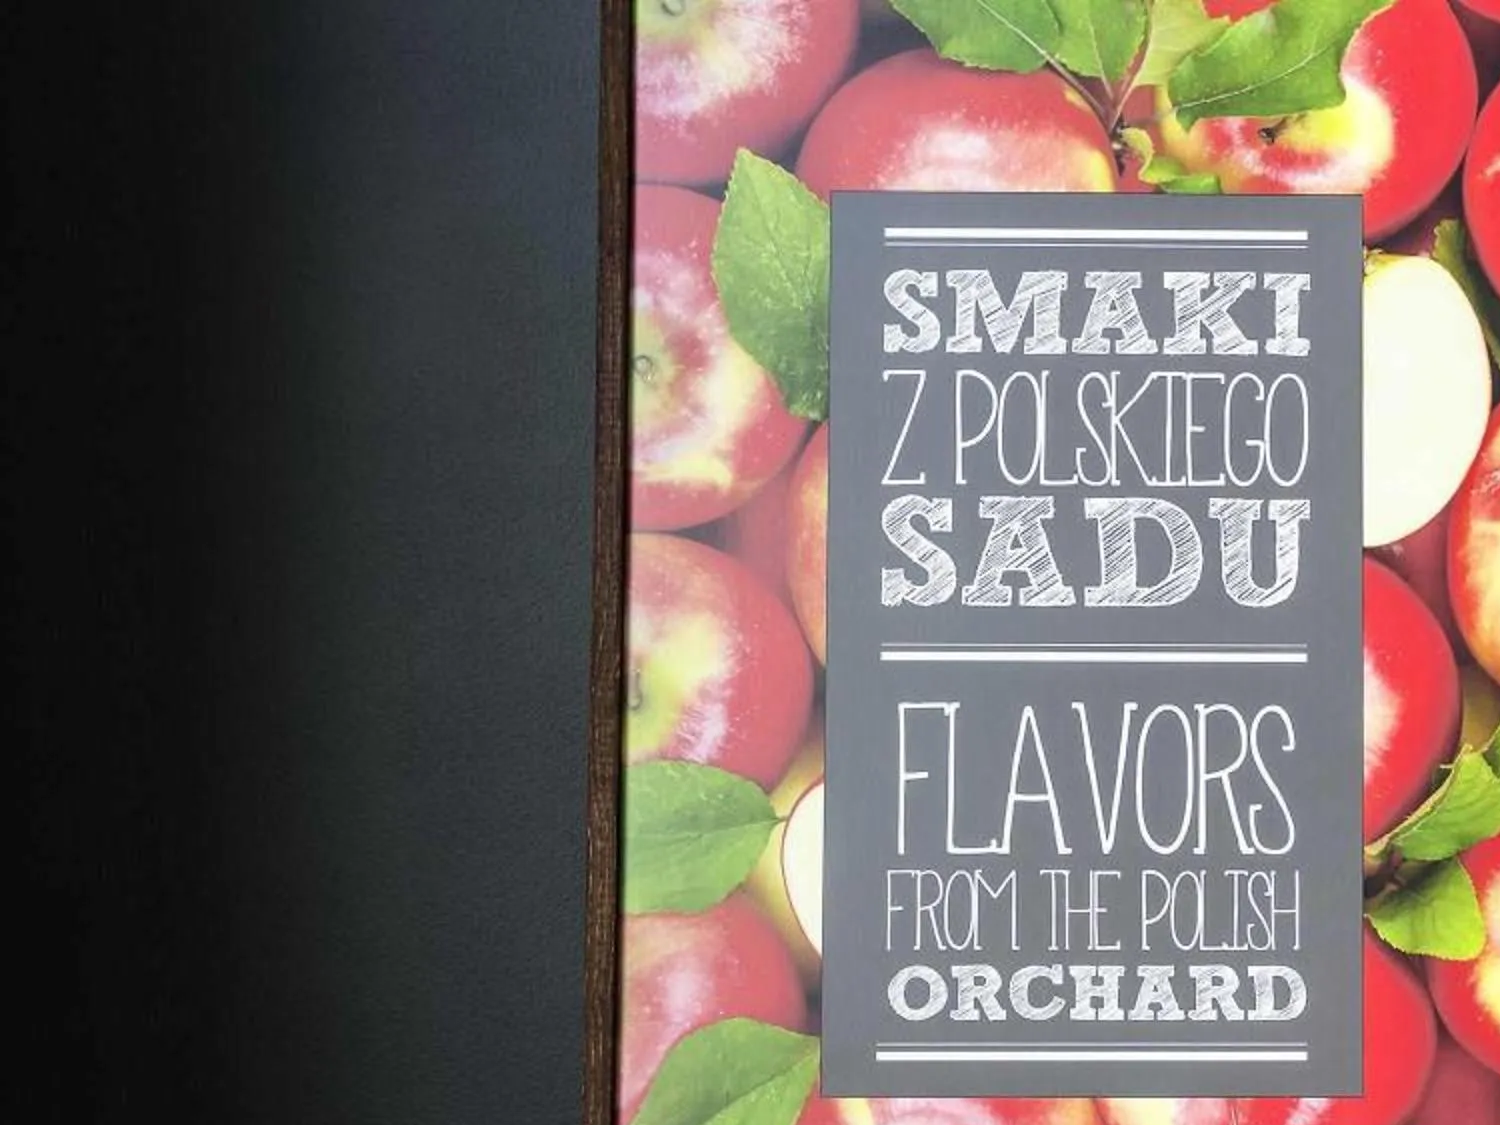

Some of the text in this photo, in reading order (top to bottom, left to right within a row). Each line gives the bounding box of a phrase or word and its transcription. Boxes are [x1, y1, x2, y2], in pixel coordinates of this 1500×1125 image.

[883, 269, 1311, 356] SMAKI
[882, 370, 1309, 487] Z POLSKIEGO
[881, 494, 1311, 607] SADU
[898, 702, 1297, 855] FLAVORS
[886, 869, 1300, 951] FROM THE POLISH
[887, 963, 1308, 1021] ORCHARD
